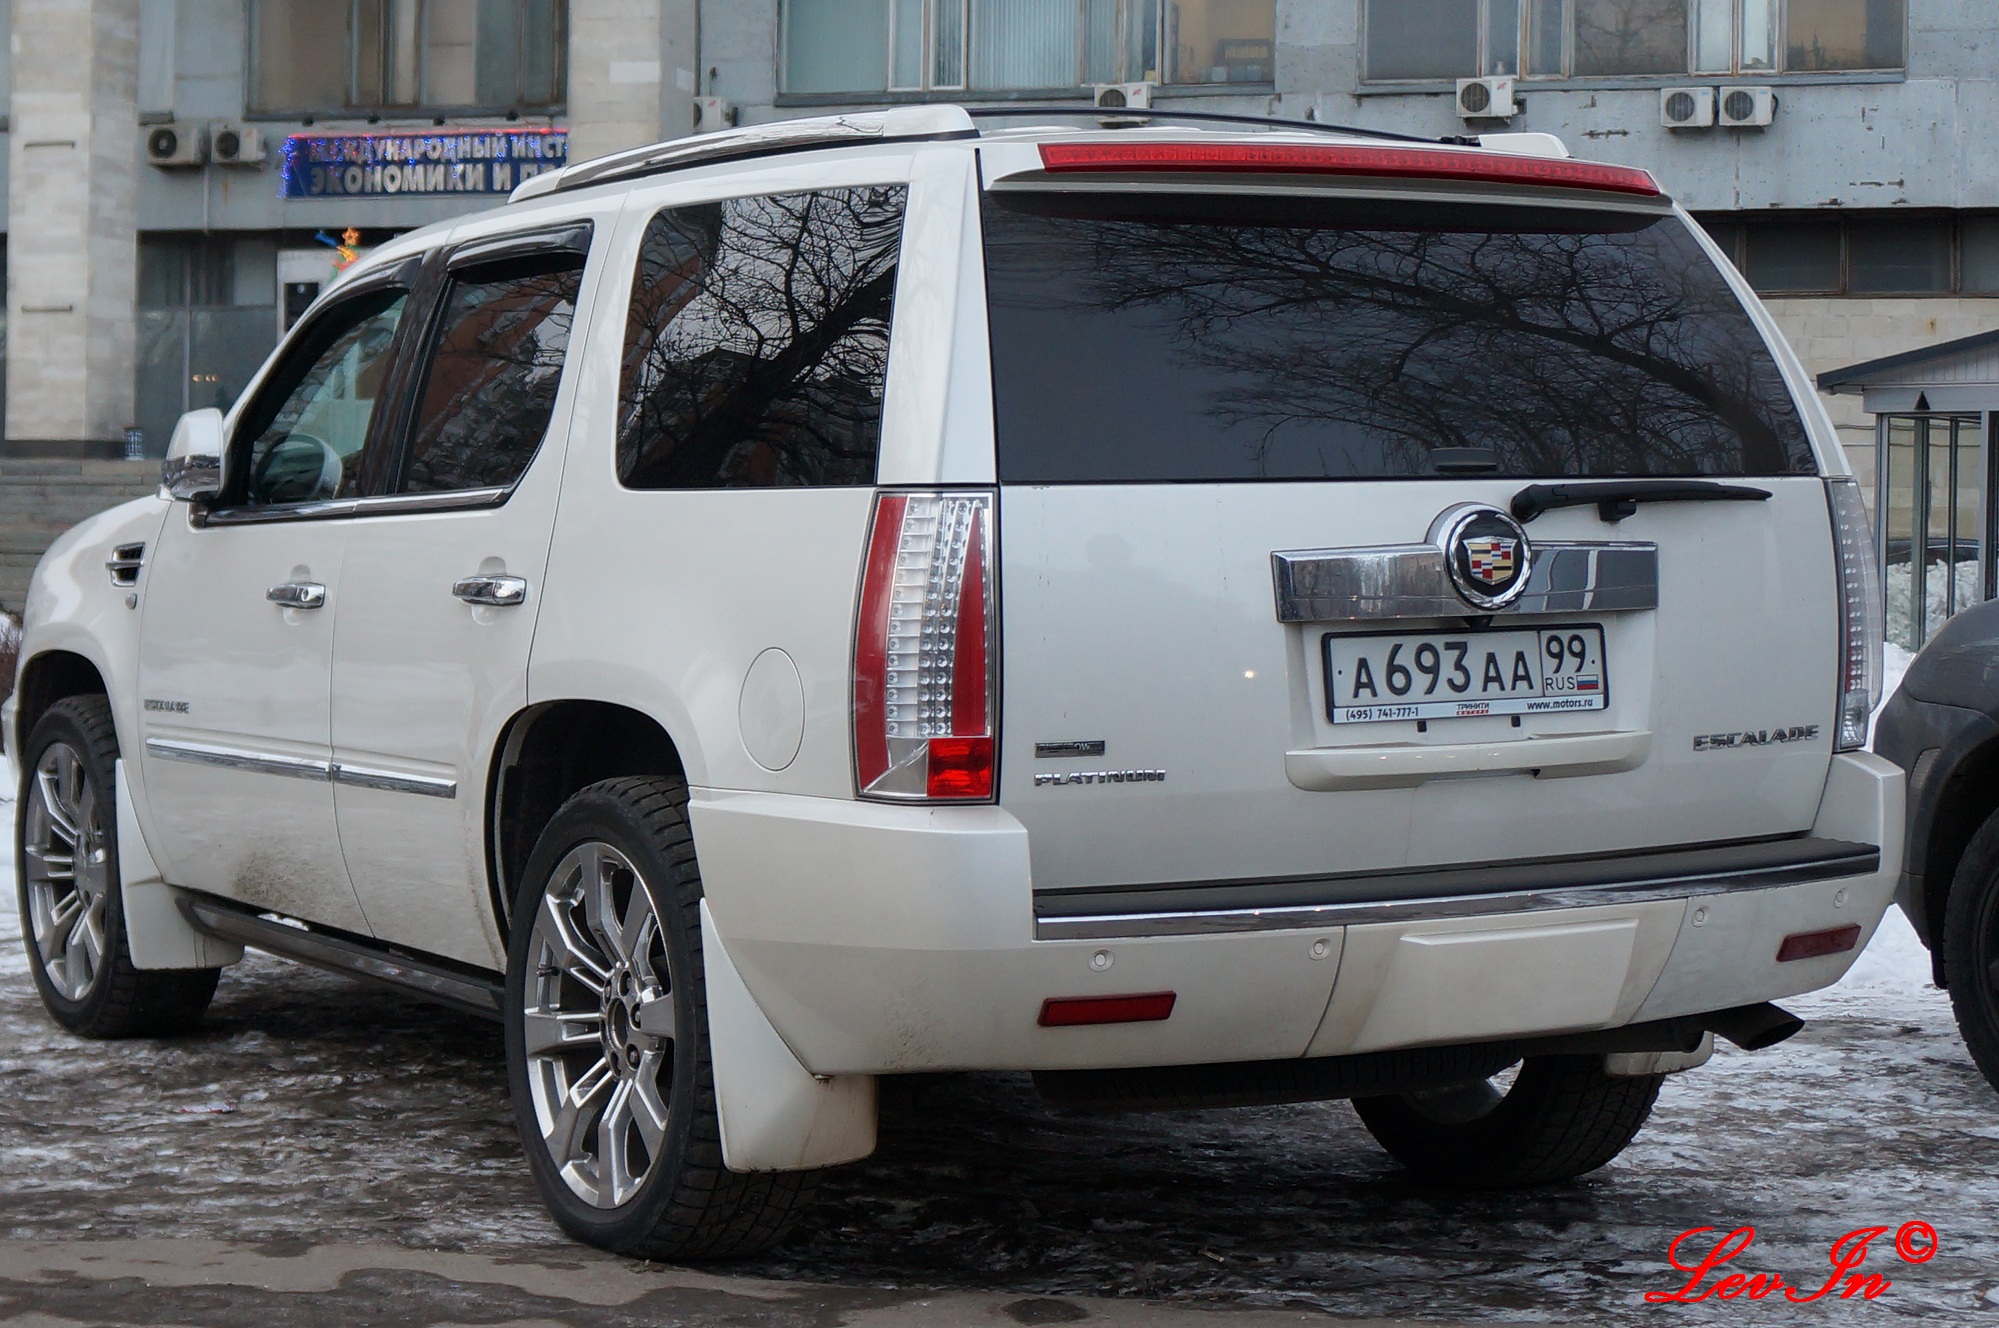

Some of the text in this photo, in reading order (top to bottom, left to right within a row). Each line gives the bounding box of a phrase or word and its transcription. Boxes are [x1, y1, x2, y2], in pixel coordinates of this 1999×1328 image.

[310, 162, 485, 194] ЭКОНОМИКИ
[492, 162, 512, 191] И
[1545, 633, 1587, 674] 99
[1545, 676, 1576, 691] RUS
[1345, 706, 1419, 721] (495) 741-777-1
[1527, 698, 1594, 711] www.motors.ru
[1692, 724, 1820, 752] ESCALADE
[1034, 769, 1166, 787] PLATINUM
